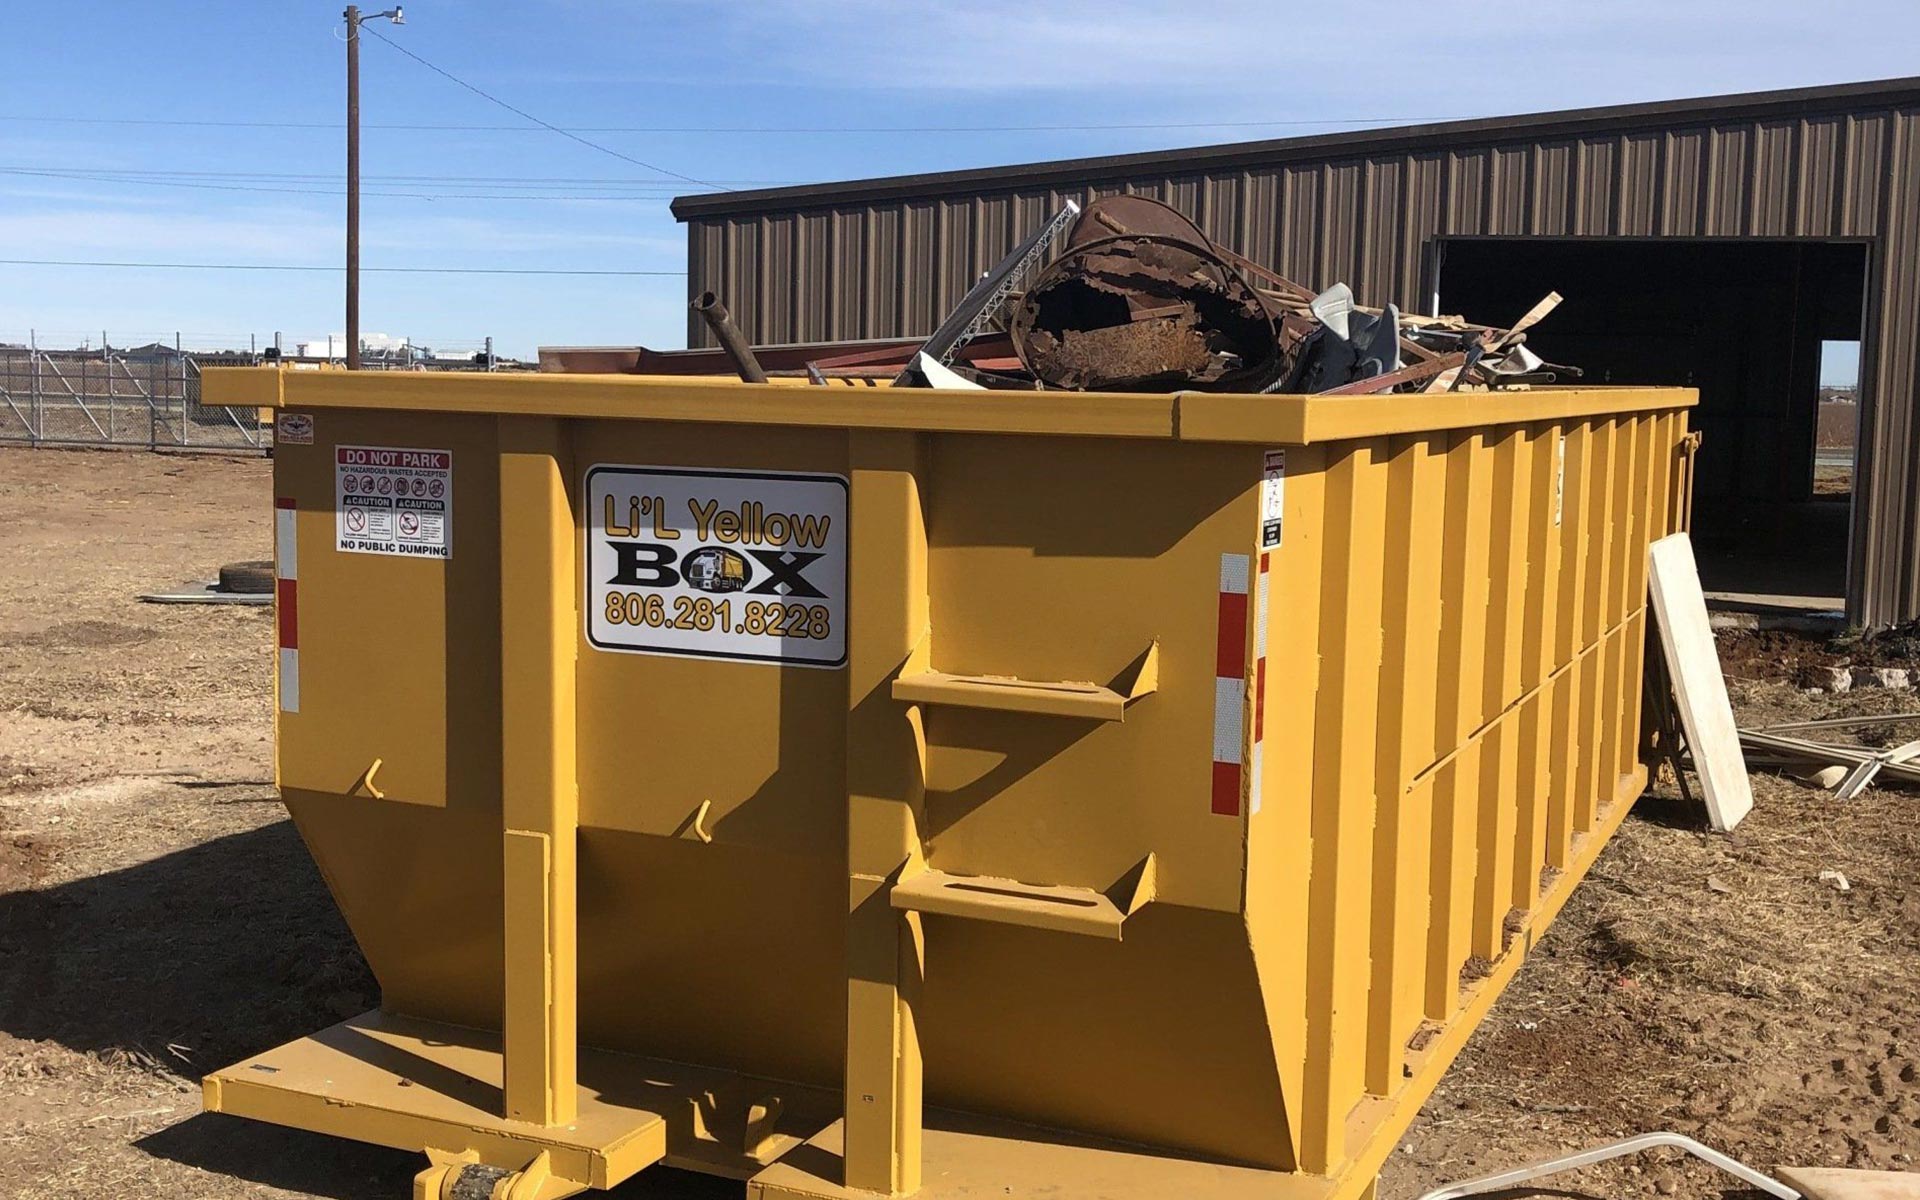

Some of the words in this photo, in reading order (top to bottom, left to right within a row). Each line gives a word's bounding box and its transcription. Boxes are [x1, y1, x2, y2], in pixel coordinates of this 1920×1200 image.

[346, 450, 366, 464] DO
[370, 452, 398, 465] NOT
[402, 454, 441, 468] PARK
[350, 467, 387, 475] HAZARDOUS
[414, 470, 448, 478] ACCEPTED
[351, 496, 390, 506] CAUTION
[404, 499, 442, 509] CAUTION
[604, 494, 681, 540] Li'L
[688, 497, 831, 549] Yellow
[340, 540, 355, 549] NO
[358, 541, 396, 552] PUBLIC
[399, 544, 448, 557] DUMPING
[605, 541, 830, 599] BOX
[605, 591, 831, 640] 806.281.8228
